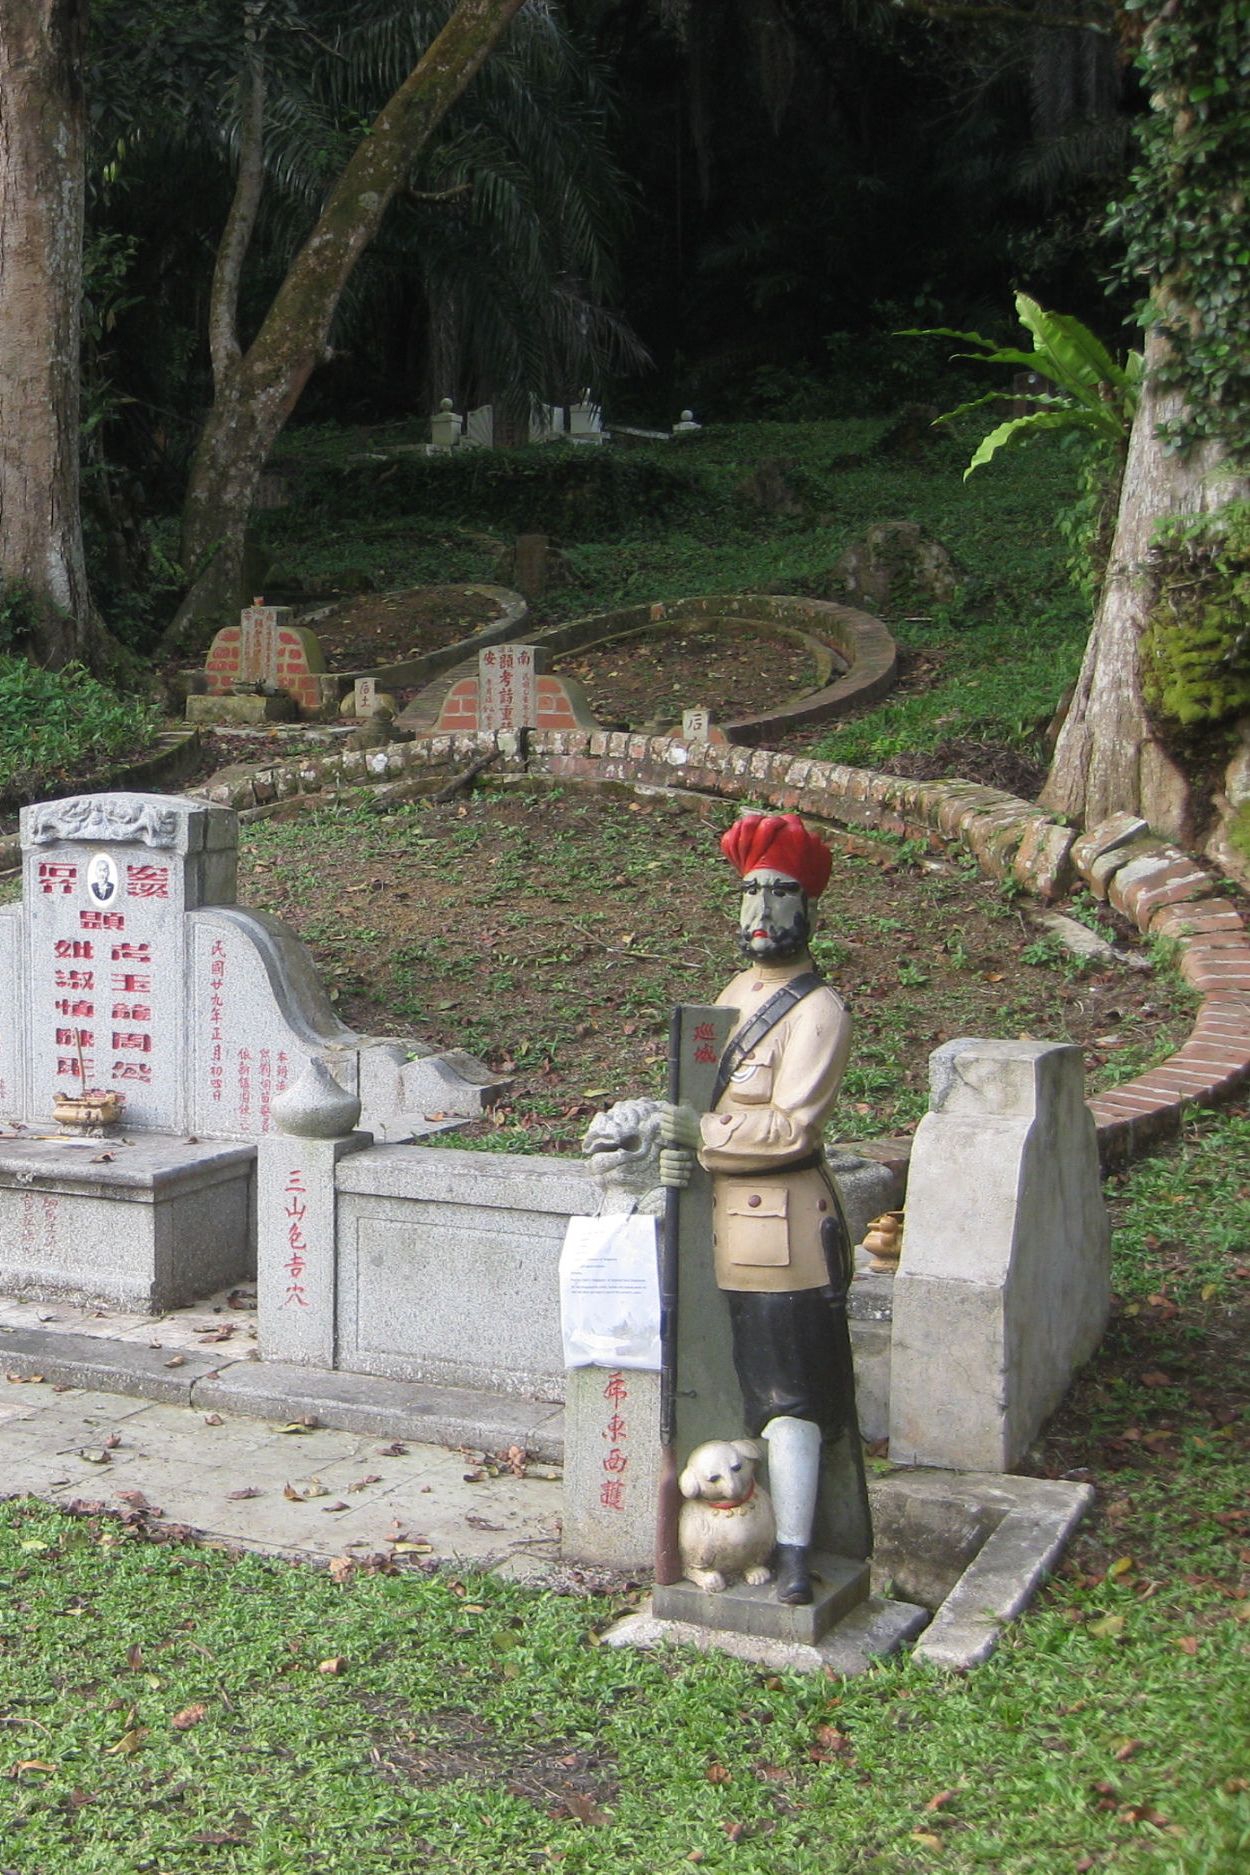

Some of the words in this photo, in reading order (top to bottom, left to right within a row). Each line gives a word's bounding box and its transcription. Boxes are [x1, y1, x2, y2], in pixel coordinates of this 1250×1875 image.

[483, 650, 497, 666] 安
[517, 650, 531, 666] 南
[360, 681, 373, 708] 后土
[79, 910, 125, 931] 顯
[54, 939, 95, 1077] 妣淑慎陳氏
[111, 943, 152, 1083] 考玉龍周公
[209, 940, 227, 1102] 民國廿九年正月初四日
[692, 1022, 718, 1064] 巡城
